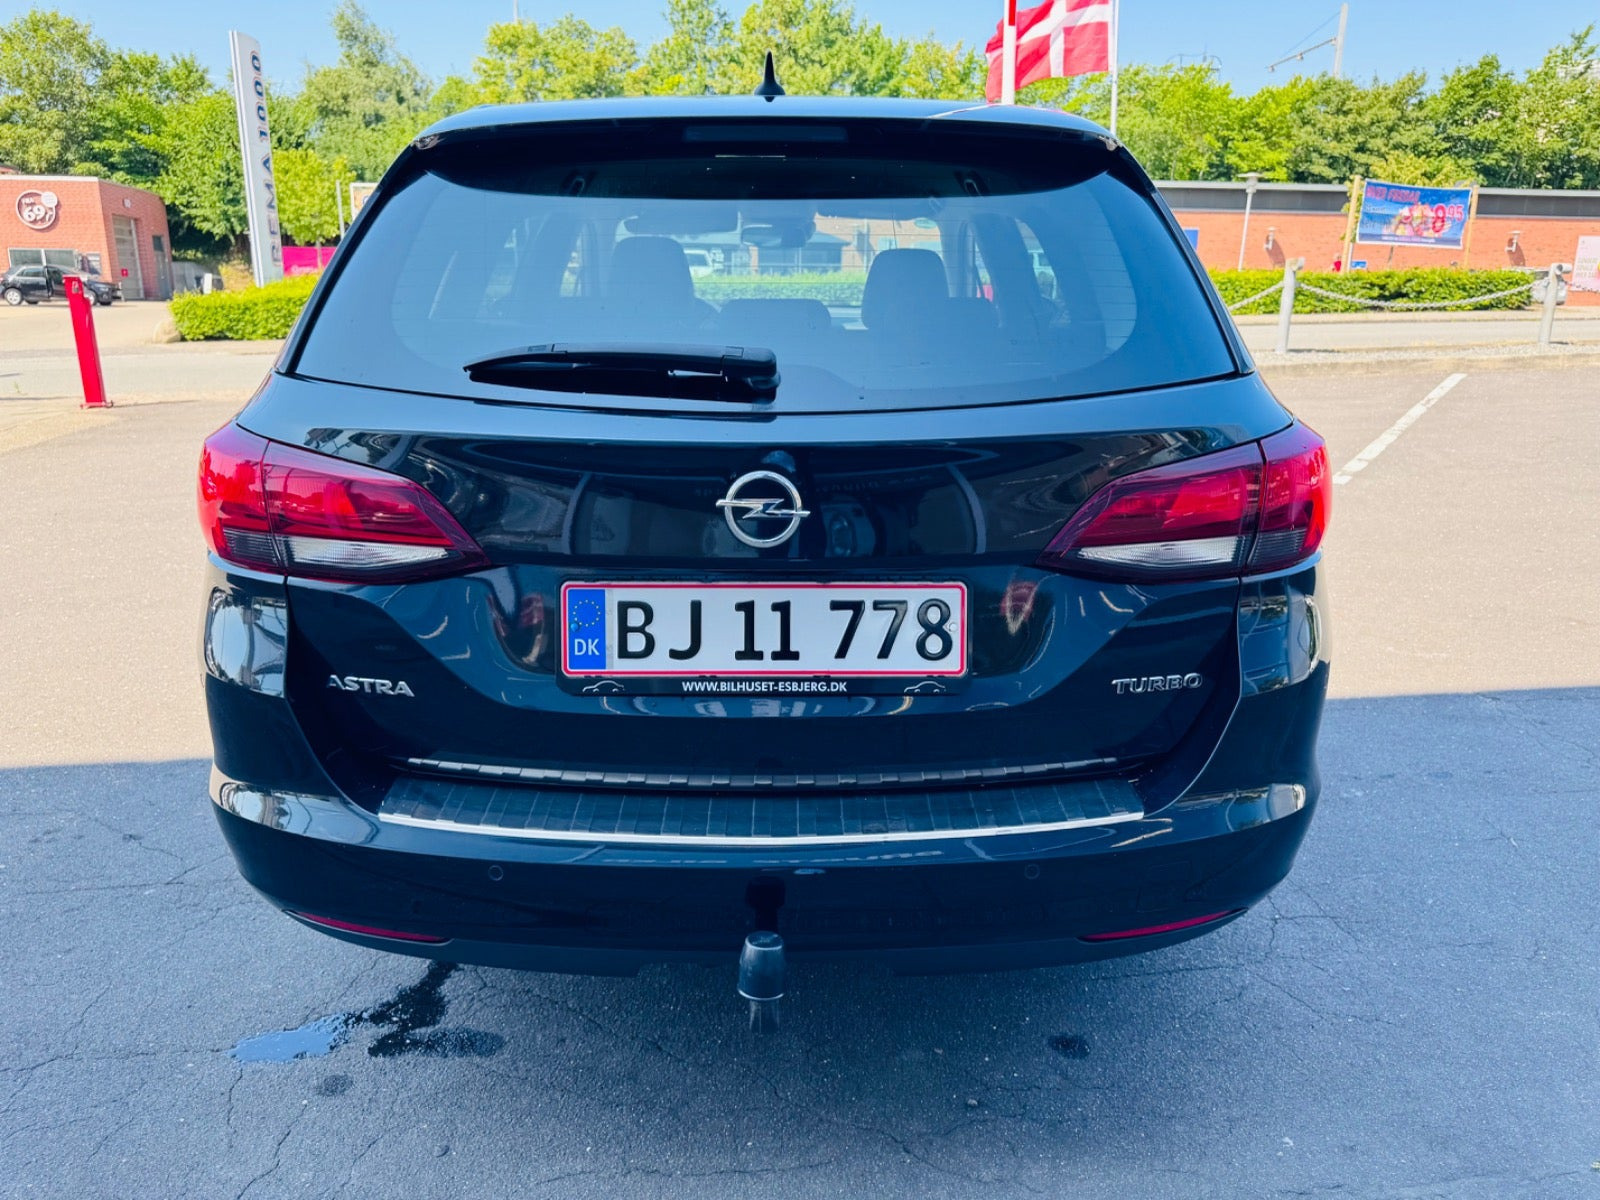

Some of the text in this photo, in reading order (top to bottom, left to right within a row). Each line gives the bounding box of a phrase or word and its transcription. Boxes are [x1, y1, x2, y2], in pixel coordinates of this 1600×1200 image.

[250, 51, 281, 267] REMA 1000
[617, 598, 953, 661] BJ 11 778
[574, 638, 600, 656] DK
[327, 674, 415, 697] ASTRA
[681, 680, 848, 693] WWW.BILHUSET-ESBJERG.DK
[1111, 672, 1203, 695] TURBO
